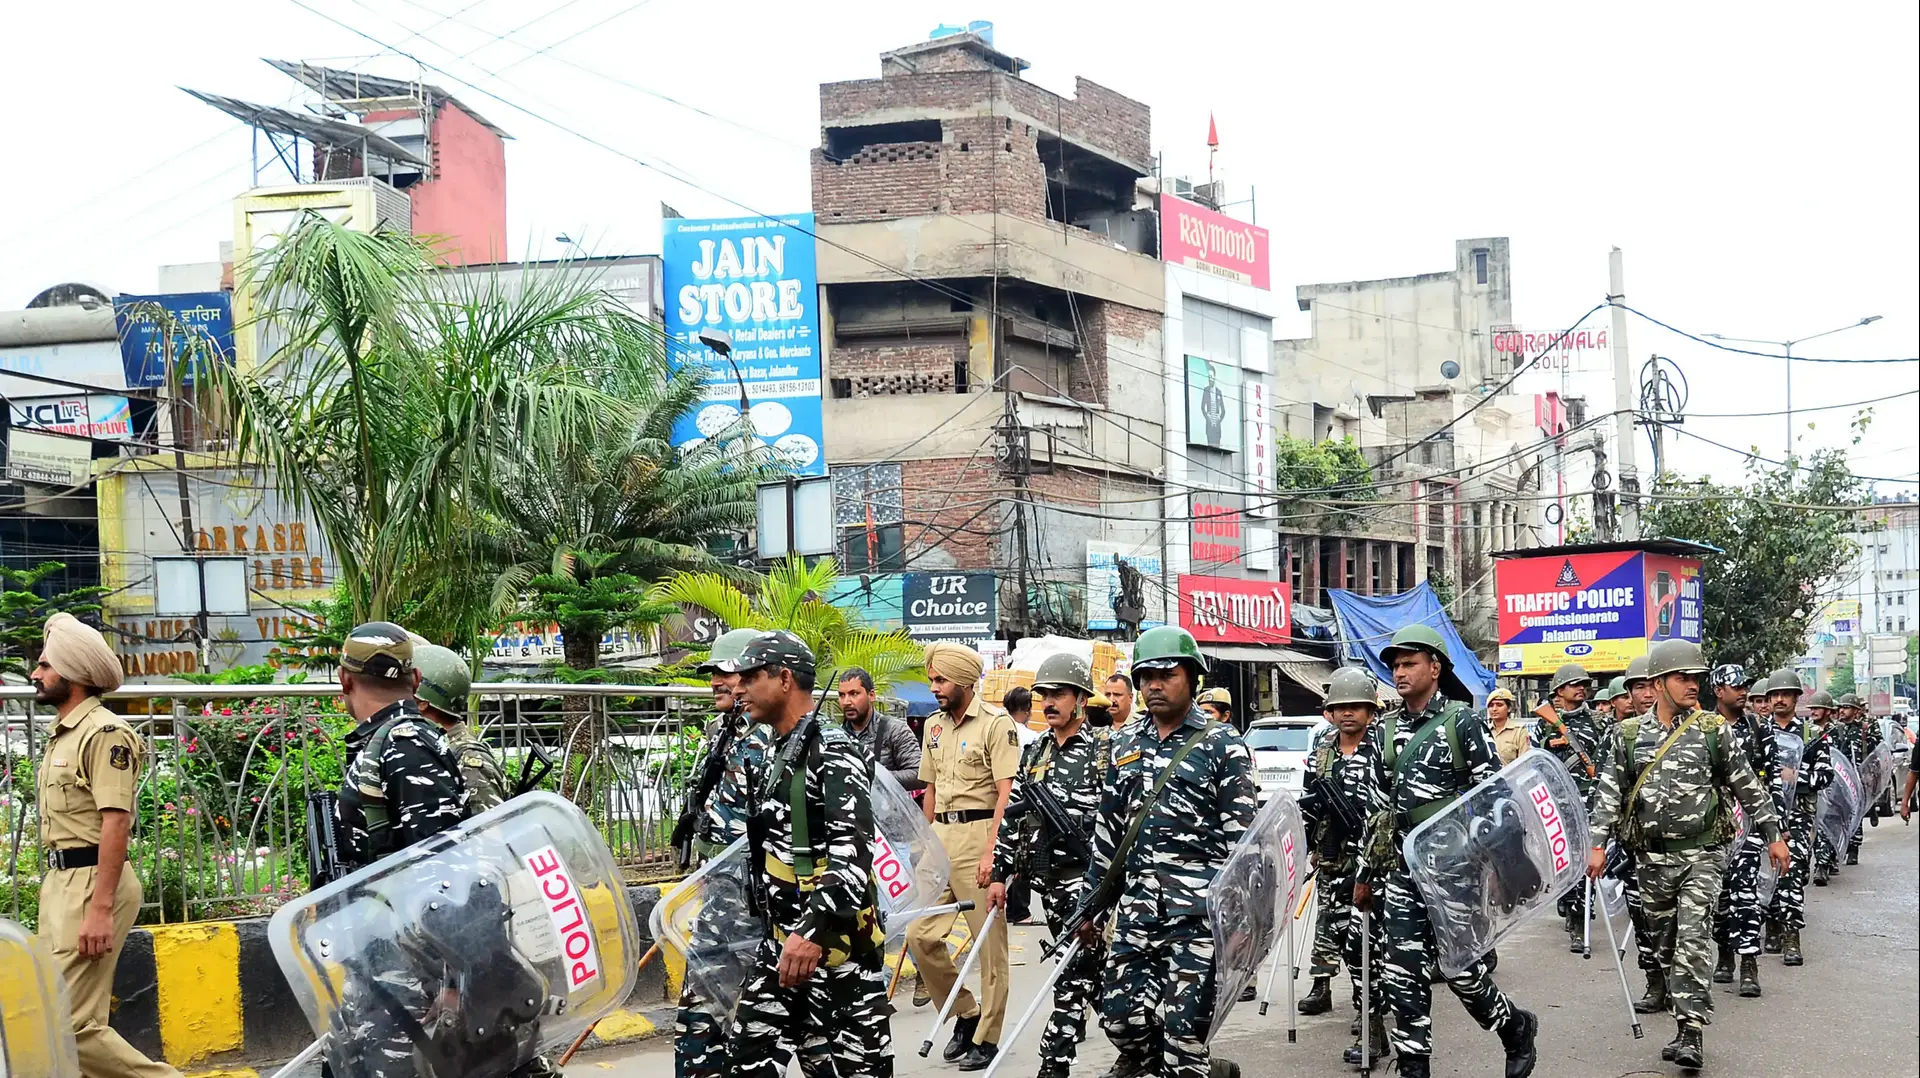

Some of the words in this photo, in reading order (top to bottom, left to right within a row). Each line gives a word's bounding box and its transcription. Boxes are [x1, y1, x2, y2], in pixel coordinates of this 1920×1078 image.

[1178, 212, 1255, 263] Raymond
[692, 235, 786, 279] JAIN
[679, 279, 803, 325] STORE
[735, 328, 757, 342] Retail
[758, 326, 786, 341] Dealers
[787, 325, 796, 339] of
[1494, 330, 1607, 357] GUJRANWALA
[1533, 355, 1569, 370] GOLD
[80, 421, 103, 437] CITY
[104, 421, 128, 434] LIVE
[1255, 385, 1264, 514] Raymond
[1194, 503, 1240, 538] SODHI
[1192, 541, 1241, 565] CREATION'S
[929, 575, 967, 595] UR
[1681, 578, 1700, 599] Don't
[911, 597, 987, 617] Choice
[1505, 591, 1570, 613] TRAFFIC
[1576, 587, 1634, 609] POLICE
[1681, 600, 1695, 618] TEXT
[1190, 588, 1286, 636] Raymond
[1520, 611, 1619, 627] Commissionerate
[1542, 629, 1598, 643] Jalandhar
[1681, 620, 1698, 637] DRIVE
[521, 647, 531, 657] &
[1568, 645, 1590, 654] PKF
[1532, 786, 1569, 872] POLICE
[529, 849, 596, 986] POLICE
